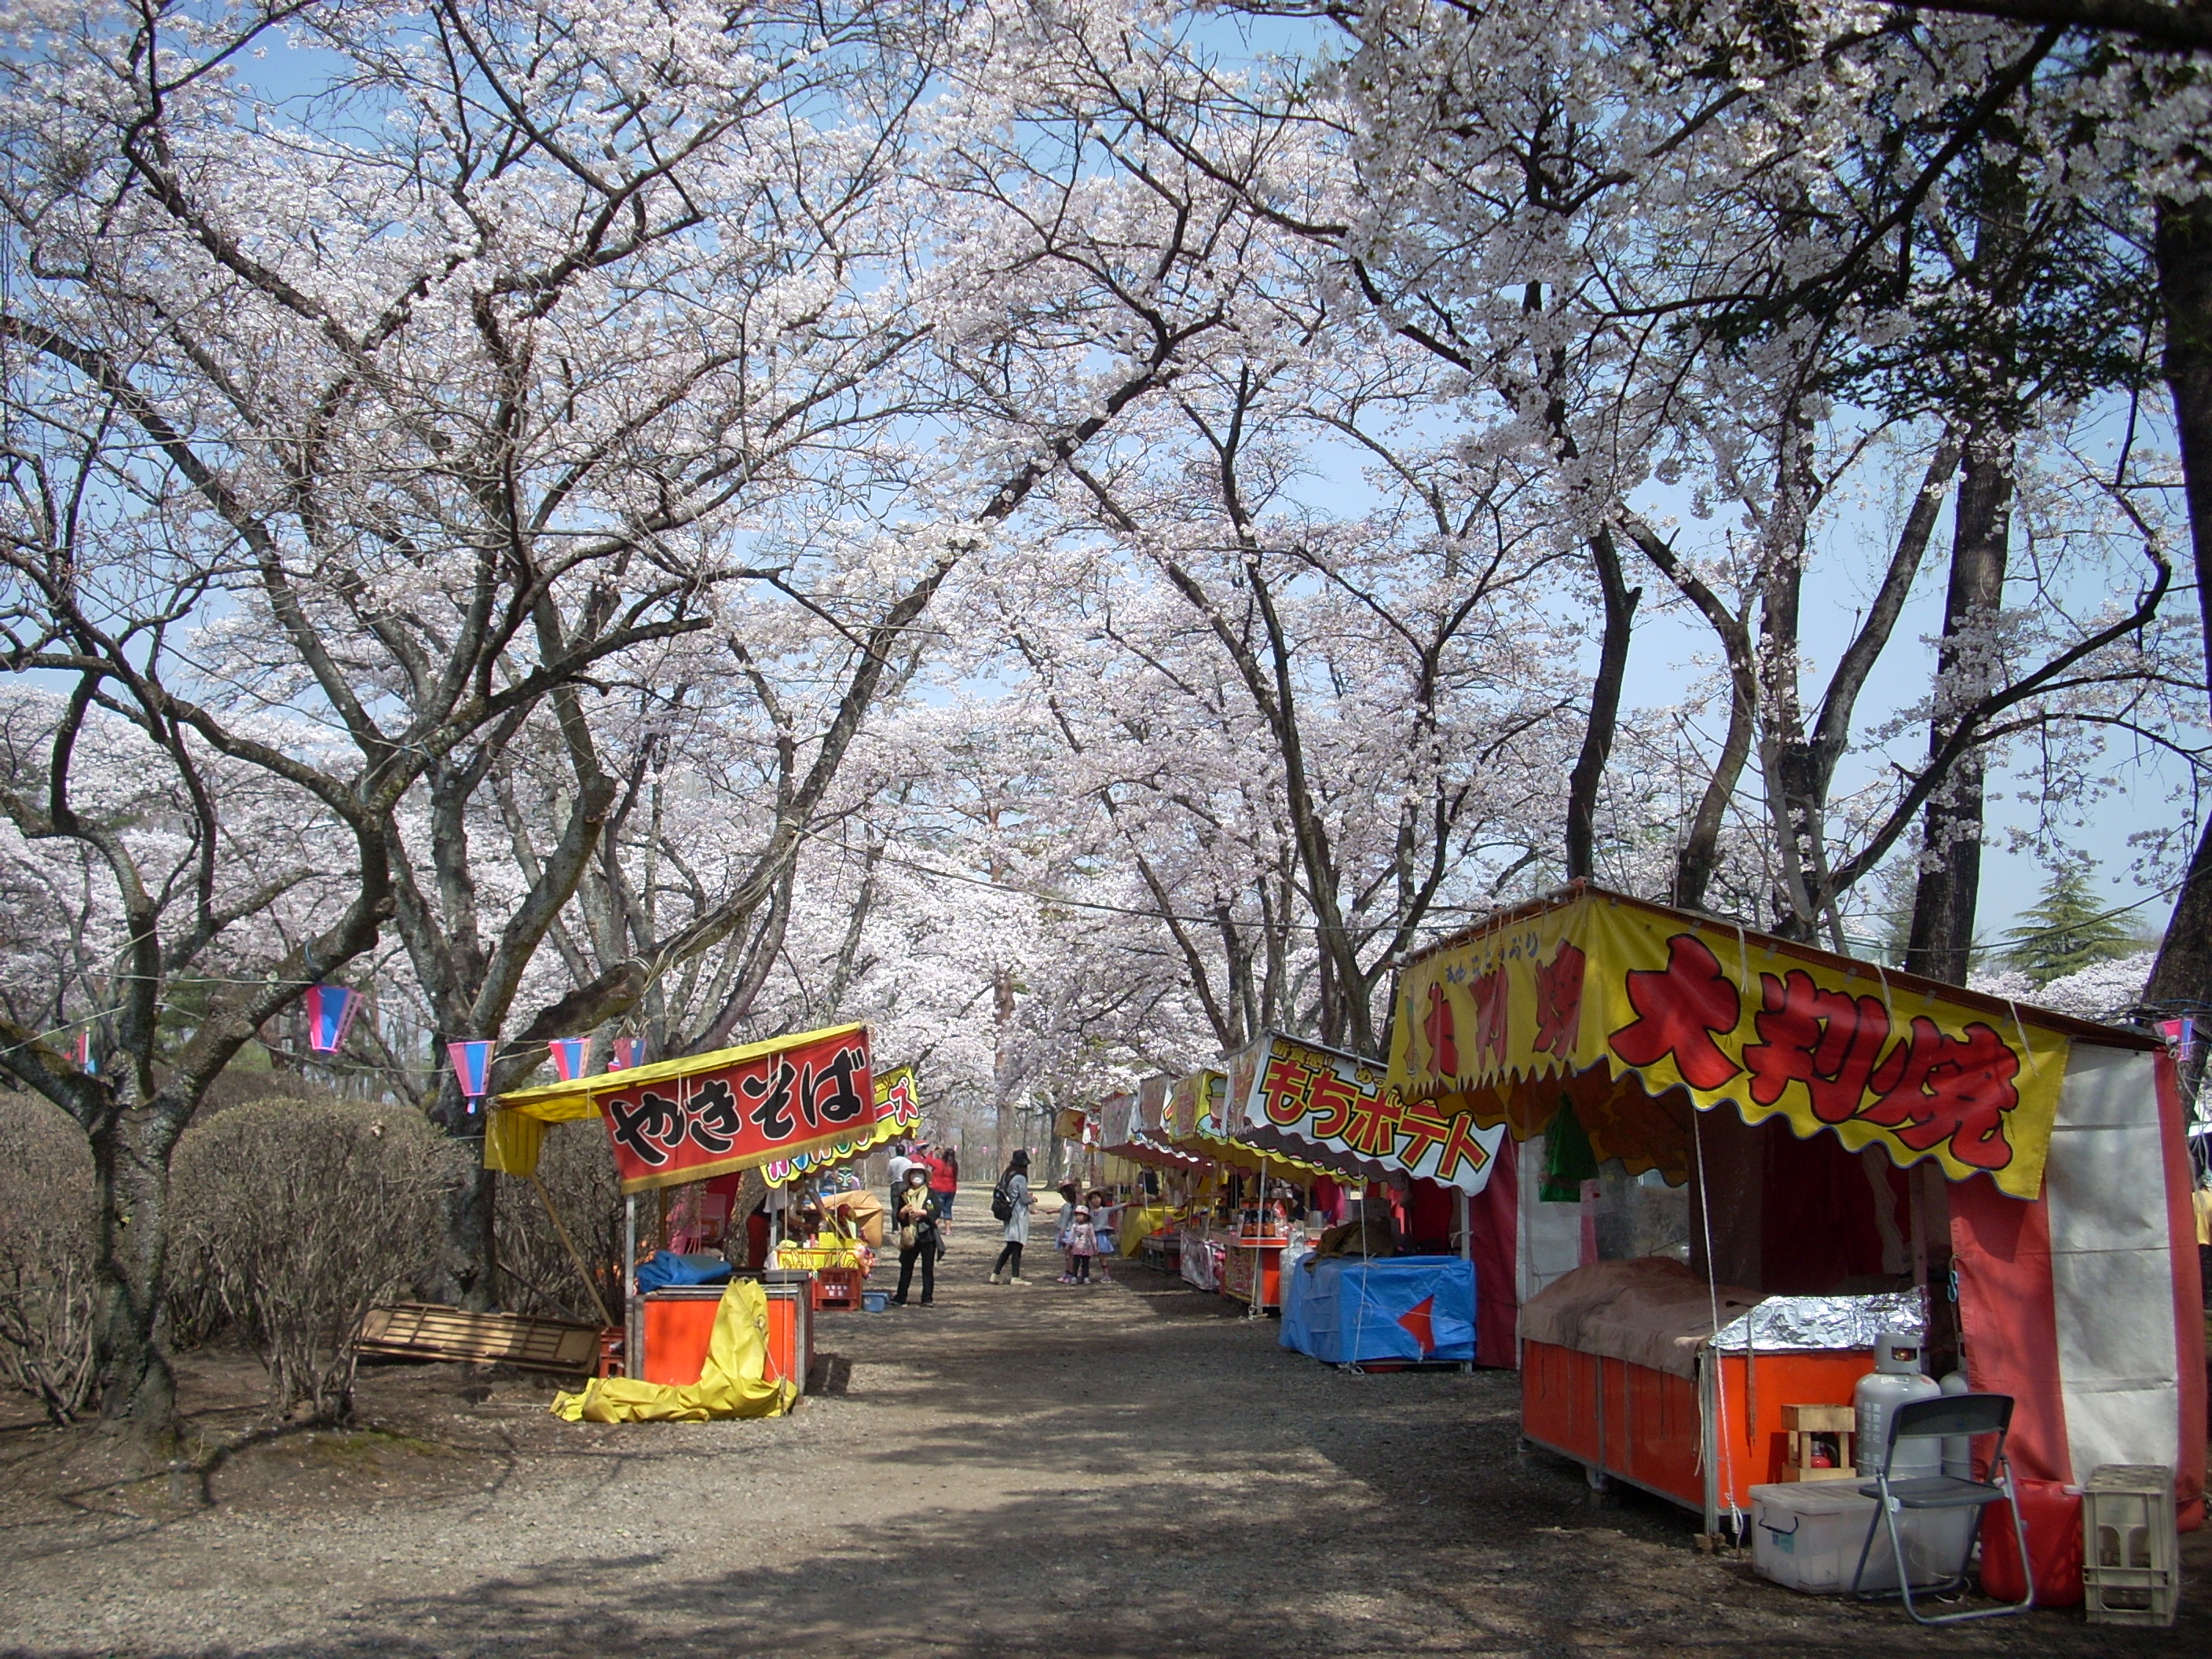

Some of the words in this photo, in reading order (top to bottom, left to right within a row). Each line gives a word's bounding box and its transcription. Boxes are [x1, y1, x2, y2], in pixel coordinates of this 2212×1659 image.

[609, 1046, 866, 1167] やきそば
[1608, 933, 2020, 1170] 大判焼
[1257, 1053, 1491, 1180] もちポテト
